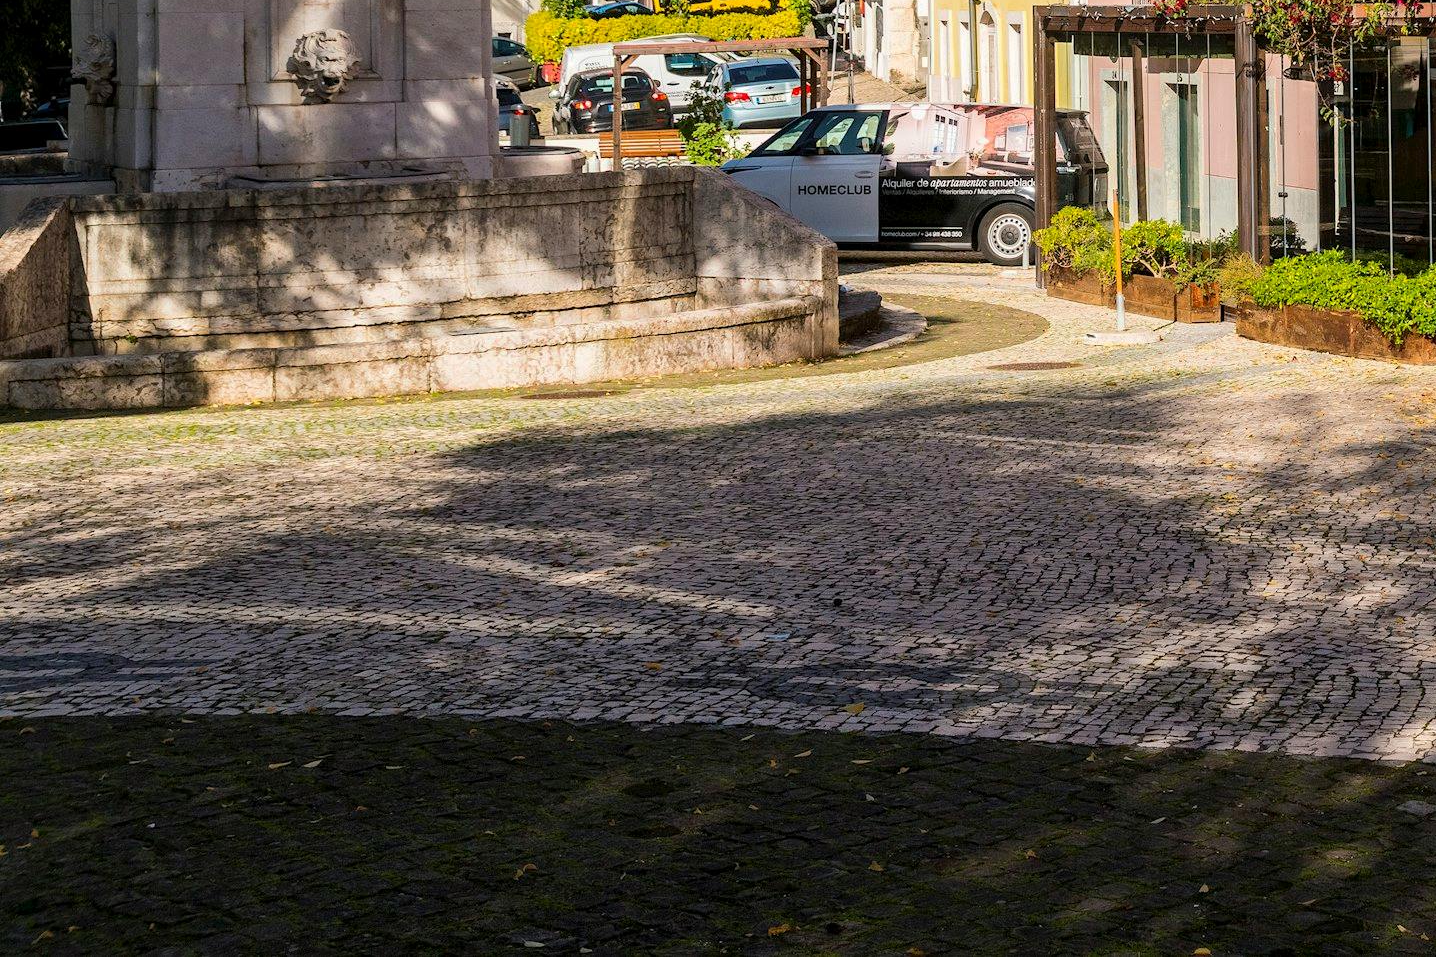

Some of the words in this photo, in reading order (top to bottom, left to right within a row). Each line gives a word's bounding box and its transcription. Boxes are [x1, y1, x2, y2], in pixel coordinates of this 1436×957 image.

[881, 178, 915, 189] Alquiler
[916, 178, 929, 188] de
[930, 178, 988, 190] apartamentos
[798, 185, 872, 195] HOMECLUB
[939, 188, 974, 196] Interiorismo
[977, 188, 1016, 197] Management
